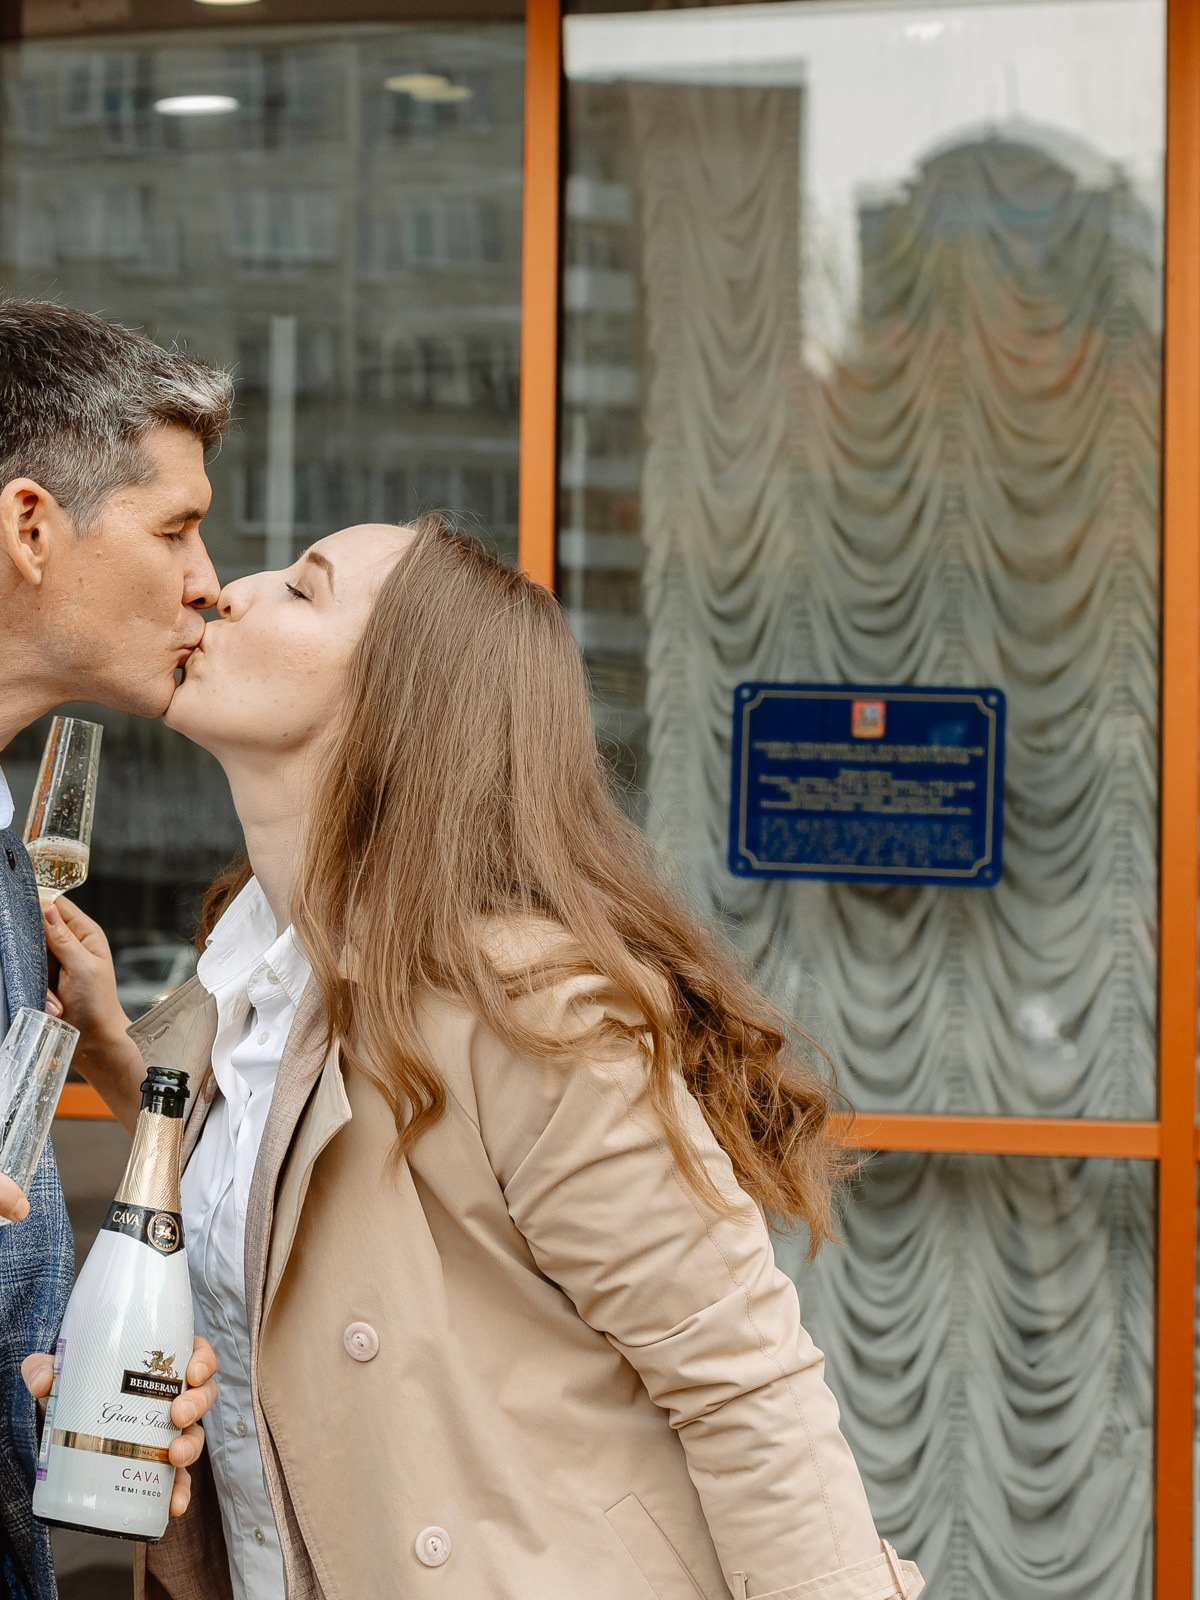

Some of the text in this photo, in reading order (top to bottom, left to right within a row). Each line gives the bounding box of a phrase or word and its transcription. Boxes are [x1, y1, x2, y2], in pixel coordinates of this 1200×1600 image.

[112, 1210, 140, 1226] CAVA
[129, 1377, 179, 1395] BERBERANA
[97, 1402, 138, 1425] Gran
[121, 1467, 161, 1485] CAVA
[114, 1484, 162, 1498] SEMI SECO
